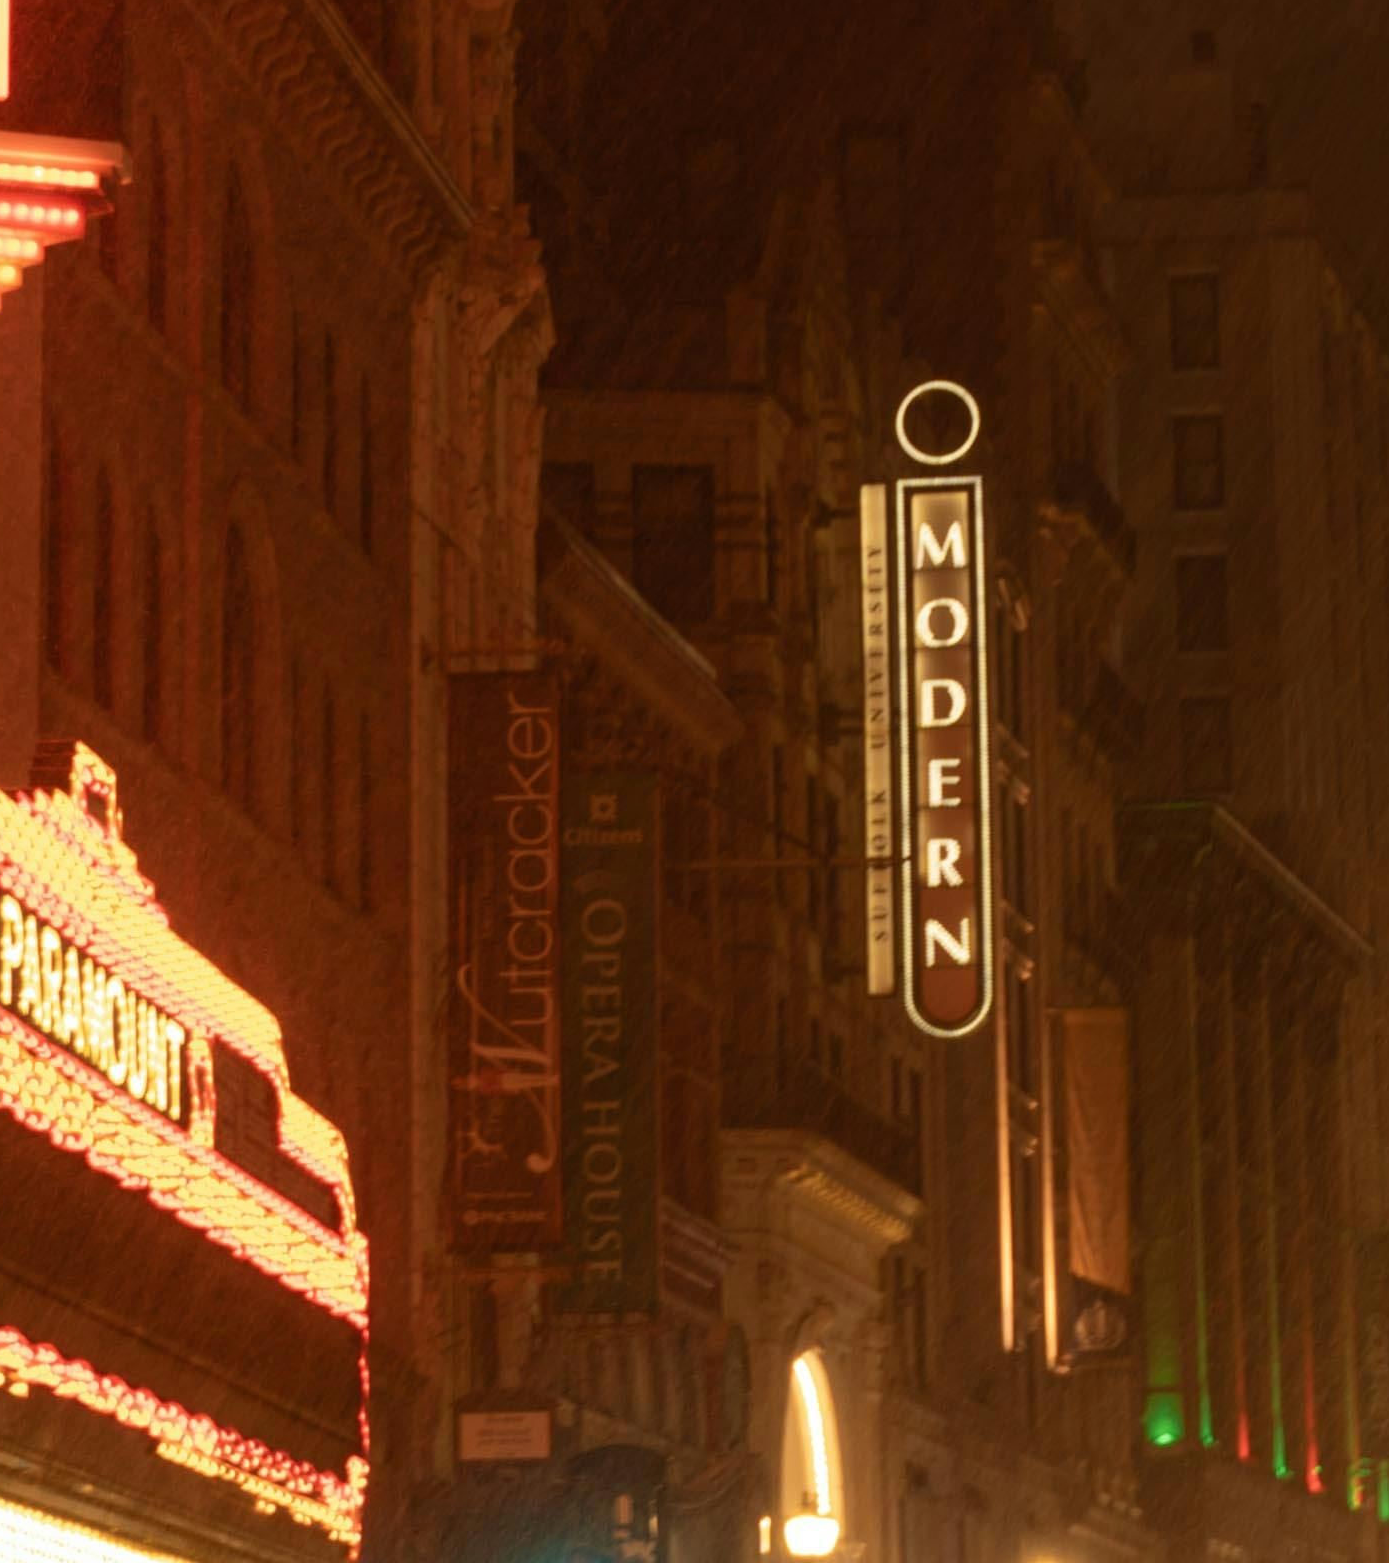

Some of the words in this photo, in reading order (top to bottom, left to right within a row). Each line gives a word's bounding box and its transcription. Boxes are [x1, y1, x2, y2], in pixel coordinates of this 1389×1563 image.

[914, 520, 969, 968] MODERN
[457, 690, 556, 1174] Nutcracker
[871, 789, 887, 942] SUFOLK
[0, 893, 185, 1121] PARAMOUNT
[581, 896, 628, 1085] OPERA
[583, 1099, 623, 1283] HOUSE
